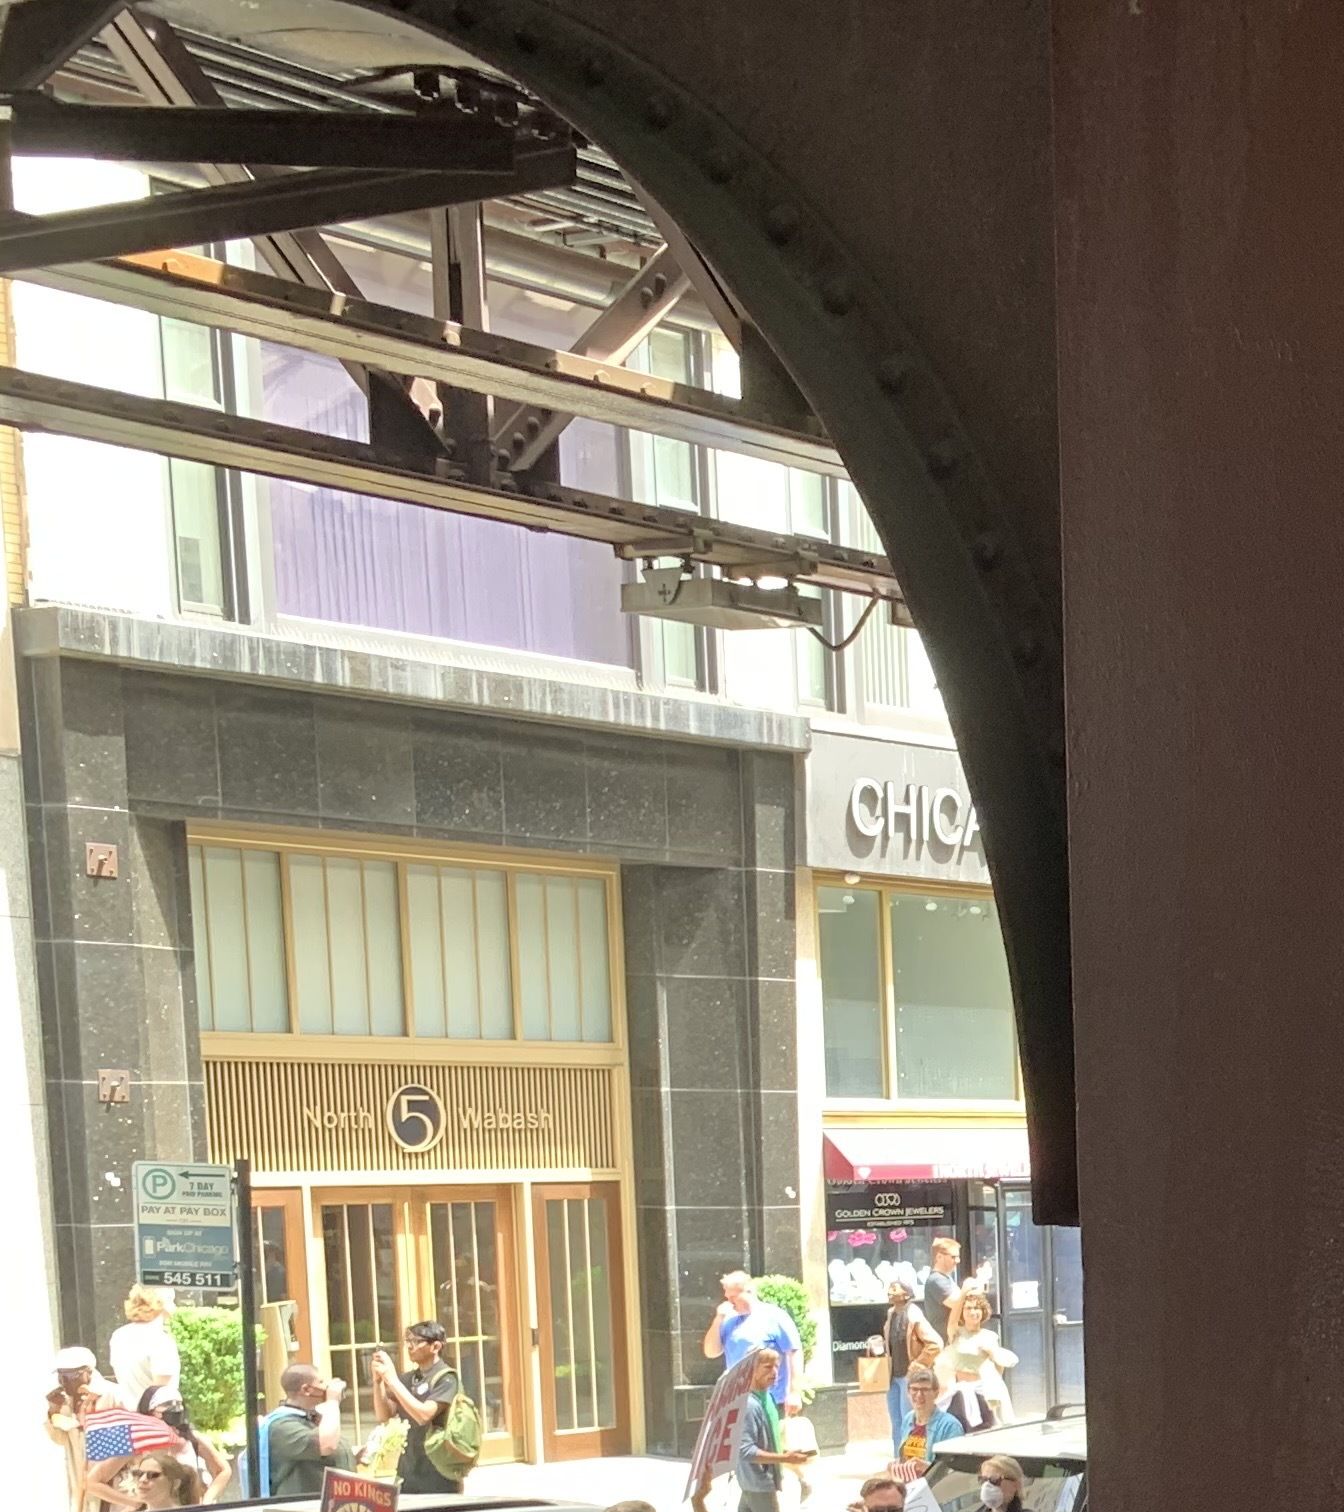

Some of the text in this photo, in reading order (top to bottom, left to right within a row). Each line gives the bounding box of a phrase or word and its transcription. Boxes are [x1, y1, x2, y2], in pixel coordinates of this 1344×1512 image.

[303, 1094, 552, 1153] North 5 Wabash
[151, 1174, 168, 1194] P
[189, 1182, 214, 1191] 7 DAY
[141, 1206, 227, 1217] PAY AT PAY BOX
[835, 1206, 944, 1218] GOLDEN CROWN JEWELERS
[164, 1272, 191, 1285] 545
[195, 1273, 221, 1286] 511
[333, 1480, 392, 1507] NO KINGS
